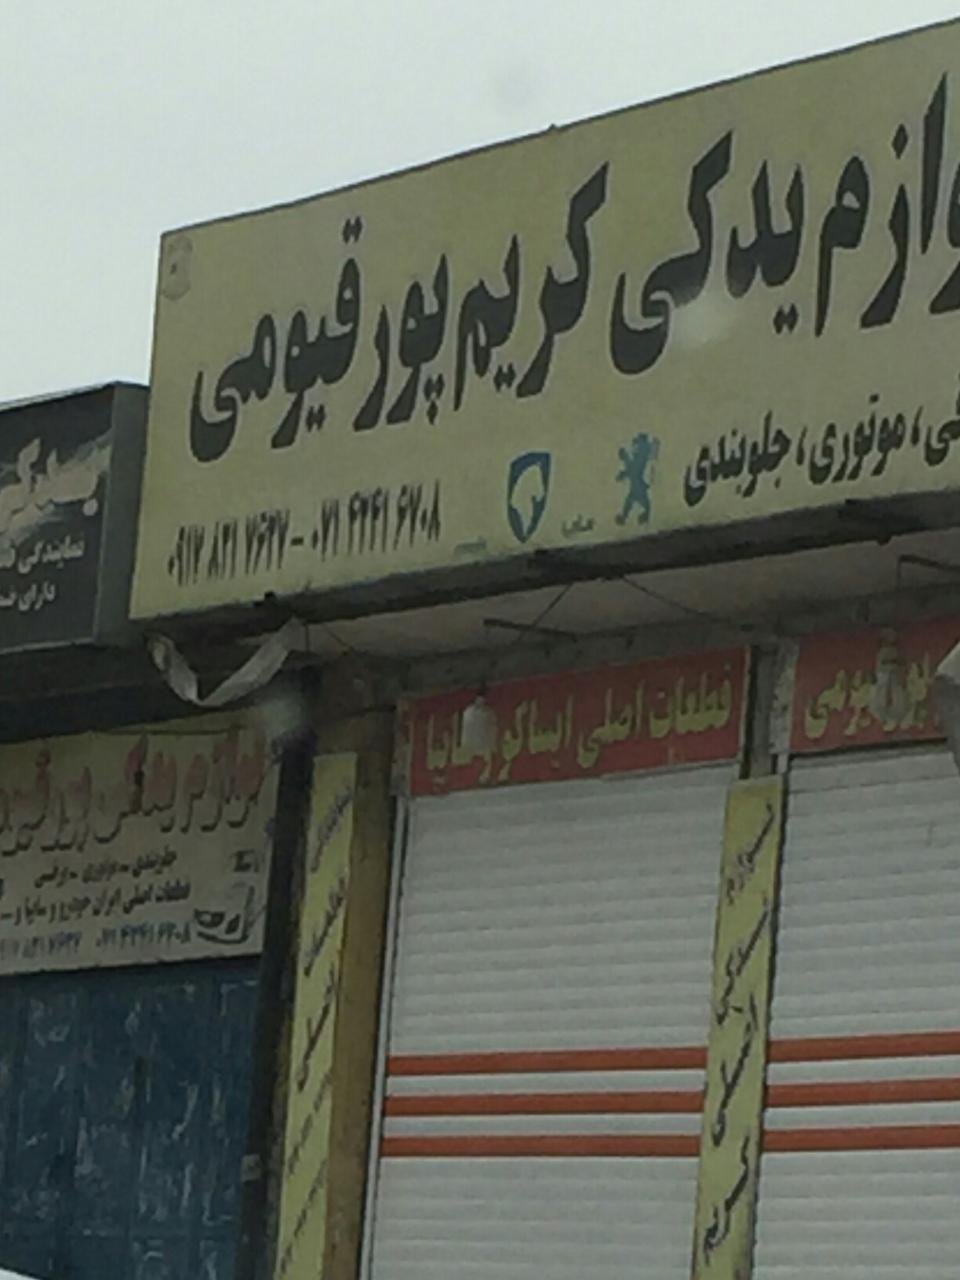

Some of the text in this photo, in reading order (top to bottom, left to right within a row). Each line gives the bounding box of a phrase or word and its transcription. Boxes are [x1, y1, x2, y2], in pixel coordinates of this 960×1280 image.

[456, 161, 609, 410] کریم
[610, 130, 803, 374] یدکی
[815, 72, 960, 336] وازم
[190, 216, 363, 463] قیومی
[683, 410, 791, 507] جلوبندی
[576, 677, 644, 768] اصلی
[648, 665, 735, 738] قطعات
[804, 669, 878, 740] یومی
